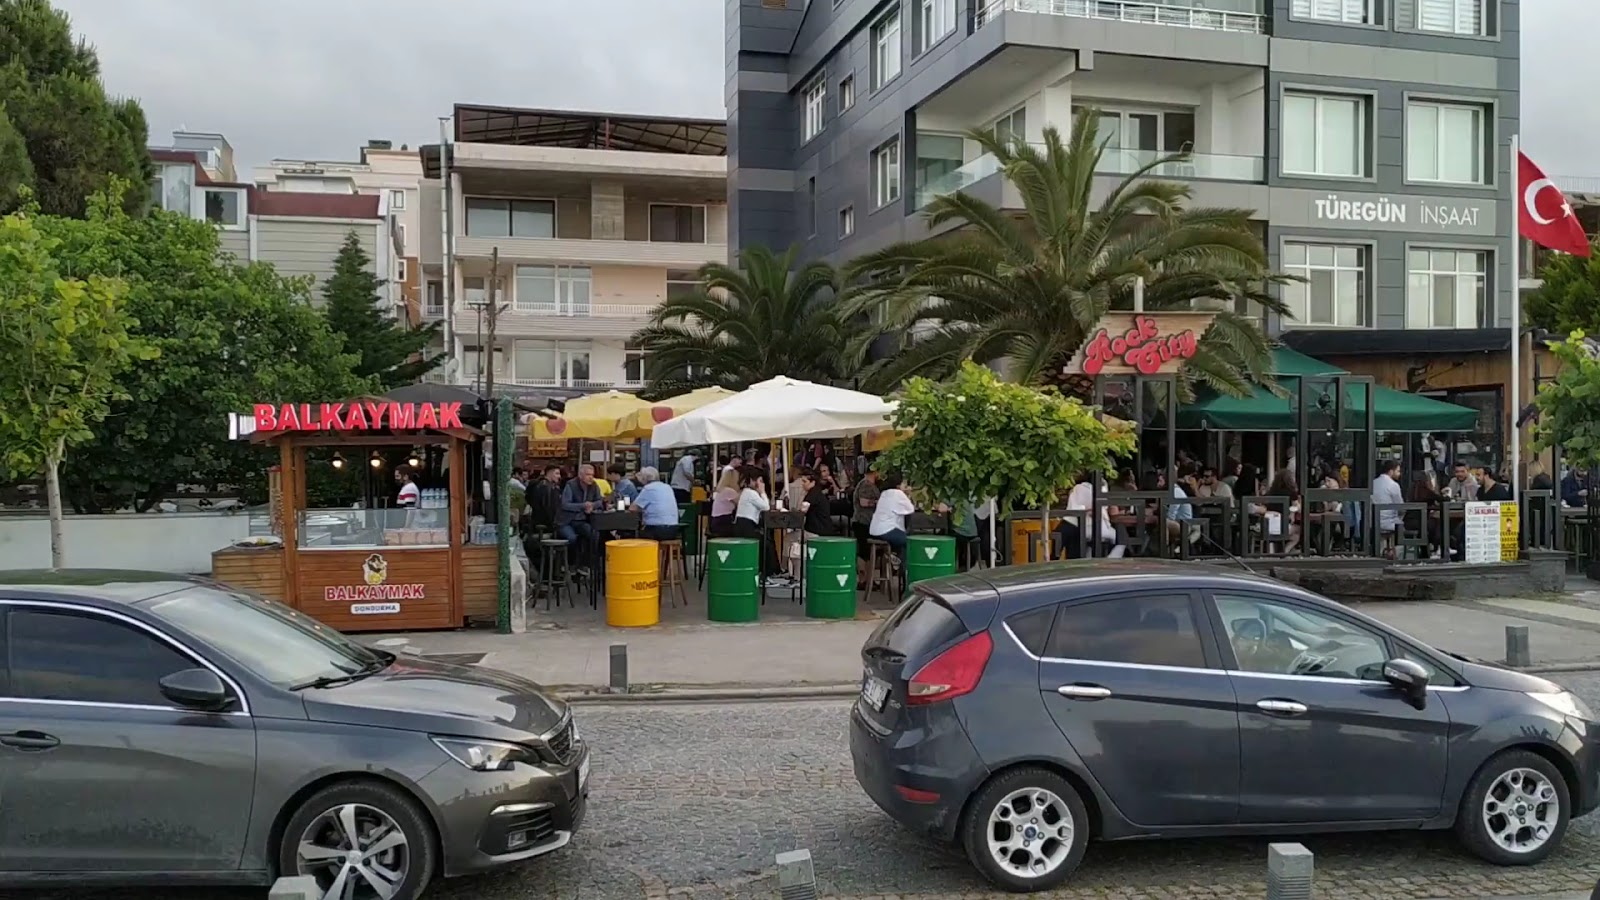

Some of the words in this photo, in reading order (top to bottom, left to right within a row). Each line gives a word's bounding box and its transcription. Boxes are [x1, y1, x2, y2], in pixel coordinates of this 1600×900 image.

[1315, 194, 1406, 223] TÜREGÜN
[1420, 200, 1480, 228] İNŞAAT
[1083, 315, 1159, 374] Rock
[1125, 328, 1197, 375] City
[253, 401, 464, 431] BALKAYMAK
[324, 583, 425, 601] BALKAYMAK
